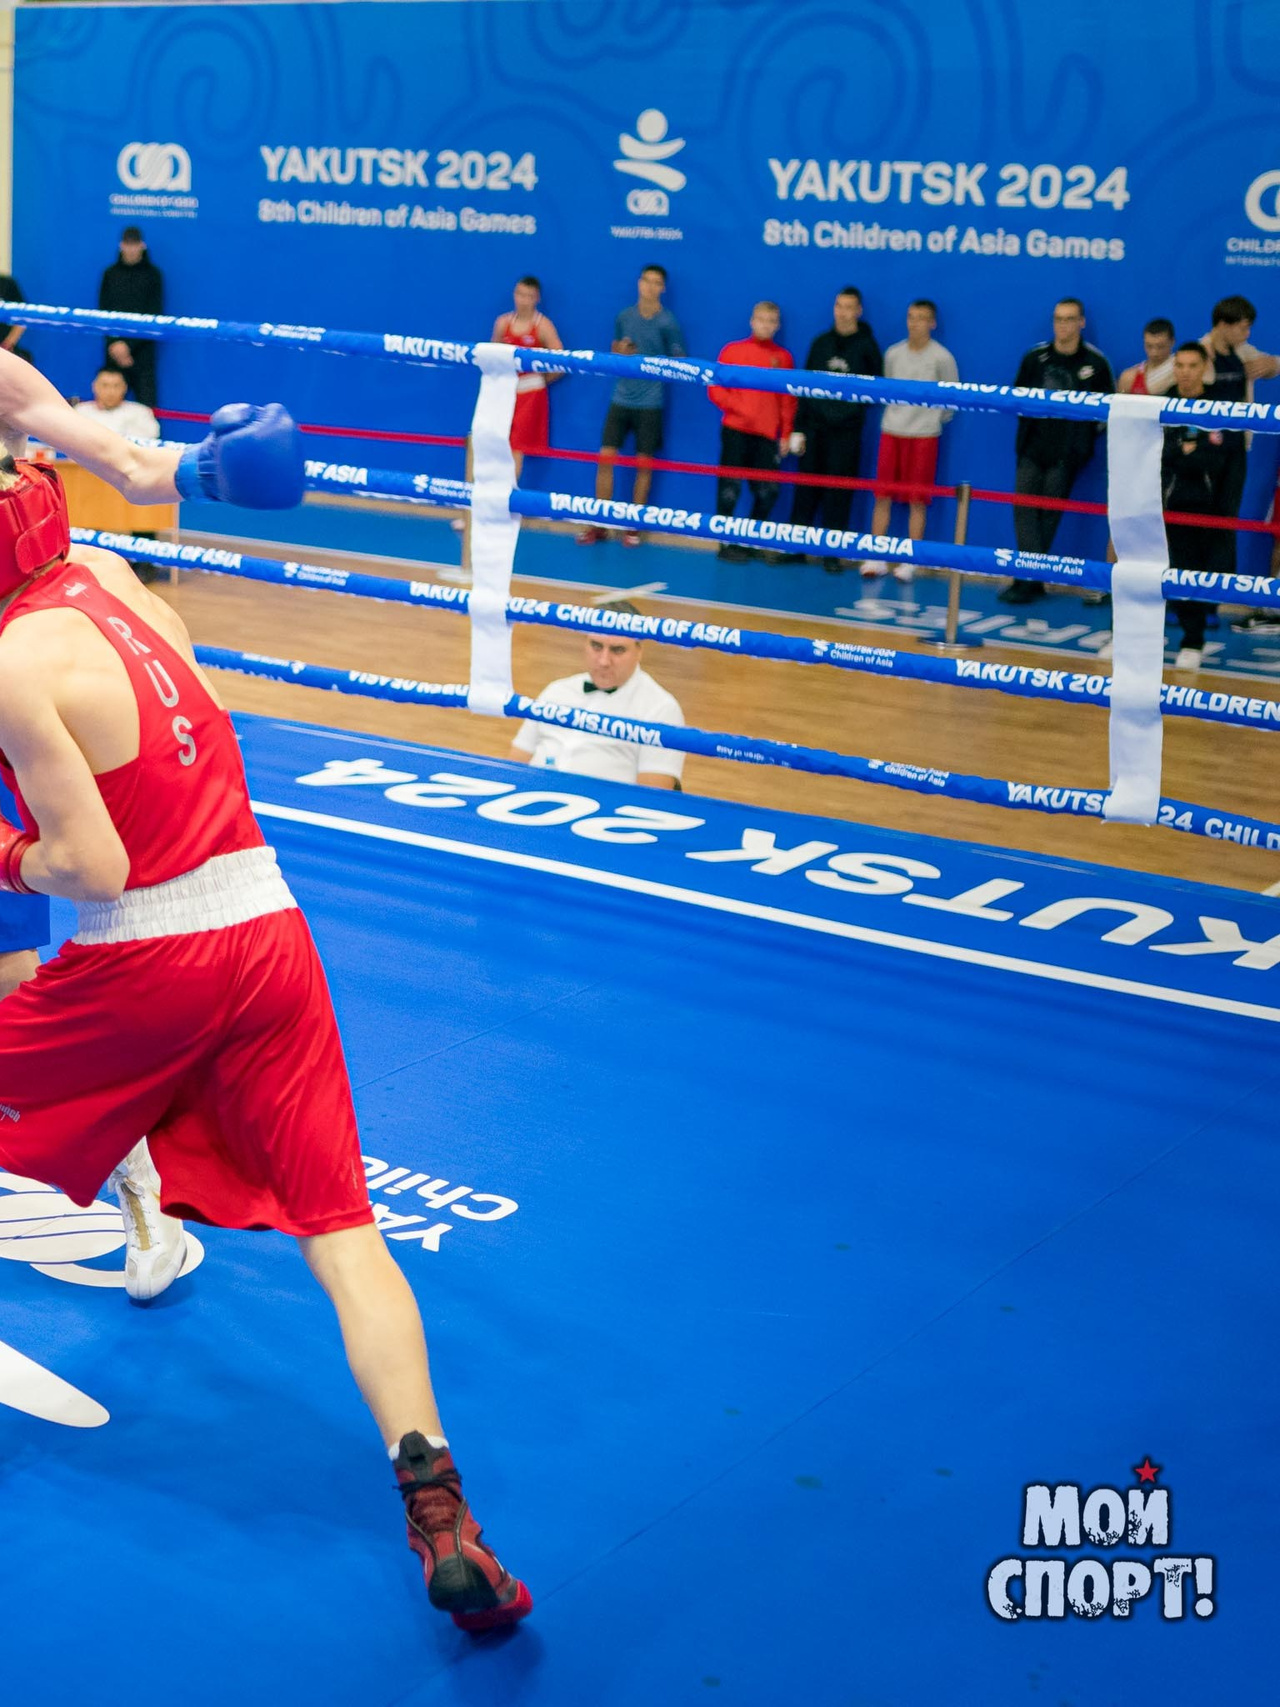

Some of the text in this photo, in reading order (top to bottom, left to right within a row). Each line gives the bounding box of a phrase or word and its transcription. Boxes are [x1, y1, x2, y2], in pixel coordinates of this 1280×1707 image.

[260, 145, 538, 192] YAKUTSK 2024
[768, 158, 1131, 212] YAKUTSK 2024
[258, 198, 538, 235] 8th Children of Asia Games
[763, 218, 1126, 262] 8th Children of Asia Games
[383, 333, 470, 364] YAKUTSK
[1161, 397, 1269, 421] ILDREN
[323, 464, 368, 487] ASIA
[549, 491, 914, 557] YAKUTSK 2024 CHILDREN OF ASIA
[98, 531, 181, 559] CHILDREN
[201, 548, 242, 570] ASIA
[1015, 557, 1083, 577] Children of Asia
[1161, 568, 1276, 595] AKUTSK
[410, 580, 471, 605] YAKUT
[556, 603, 660, 637] CHILDREN
[662, 617, 692, 639] OF
[690, 622, 741, 647] ASIA
[830, 650, 894, 669] Children of Asia
[955, 658, 1068, 692] YAKUTSK
[1069, 673, 1114, 698] 202
[107, 616, 198, 767] RUS
[572, 707, 664, 748] YAKUTSK
[884, 764, 918, 780] Children
[1007, 781, 1108, 814] YAKUTS
[1159, 805, 1193, 832] 24
[296, 757, 1280, 973] KUTSK 2024
